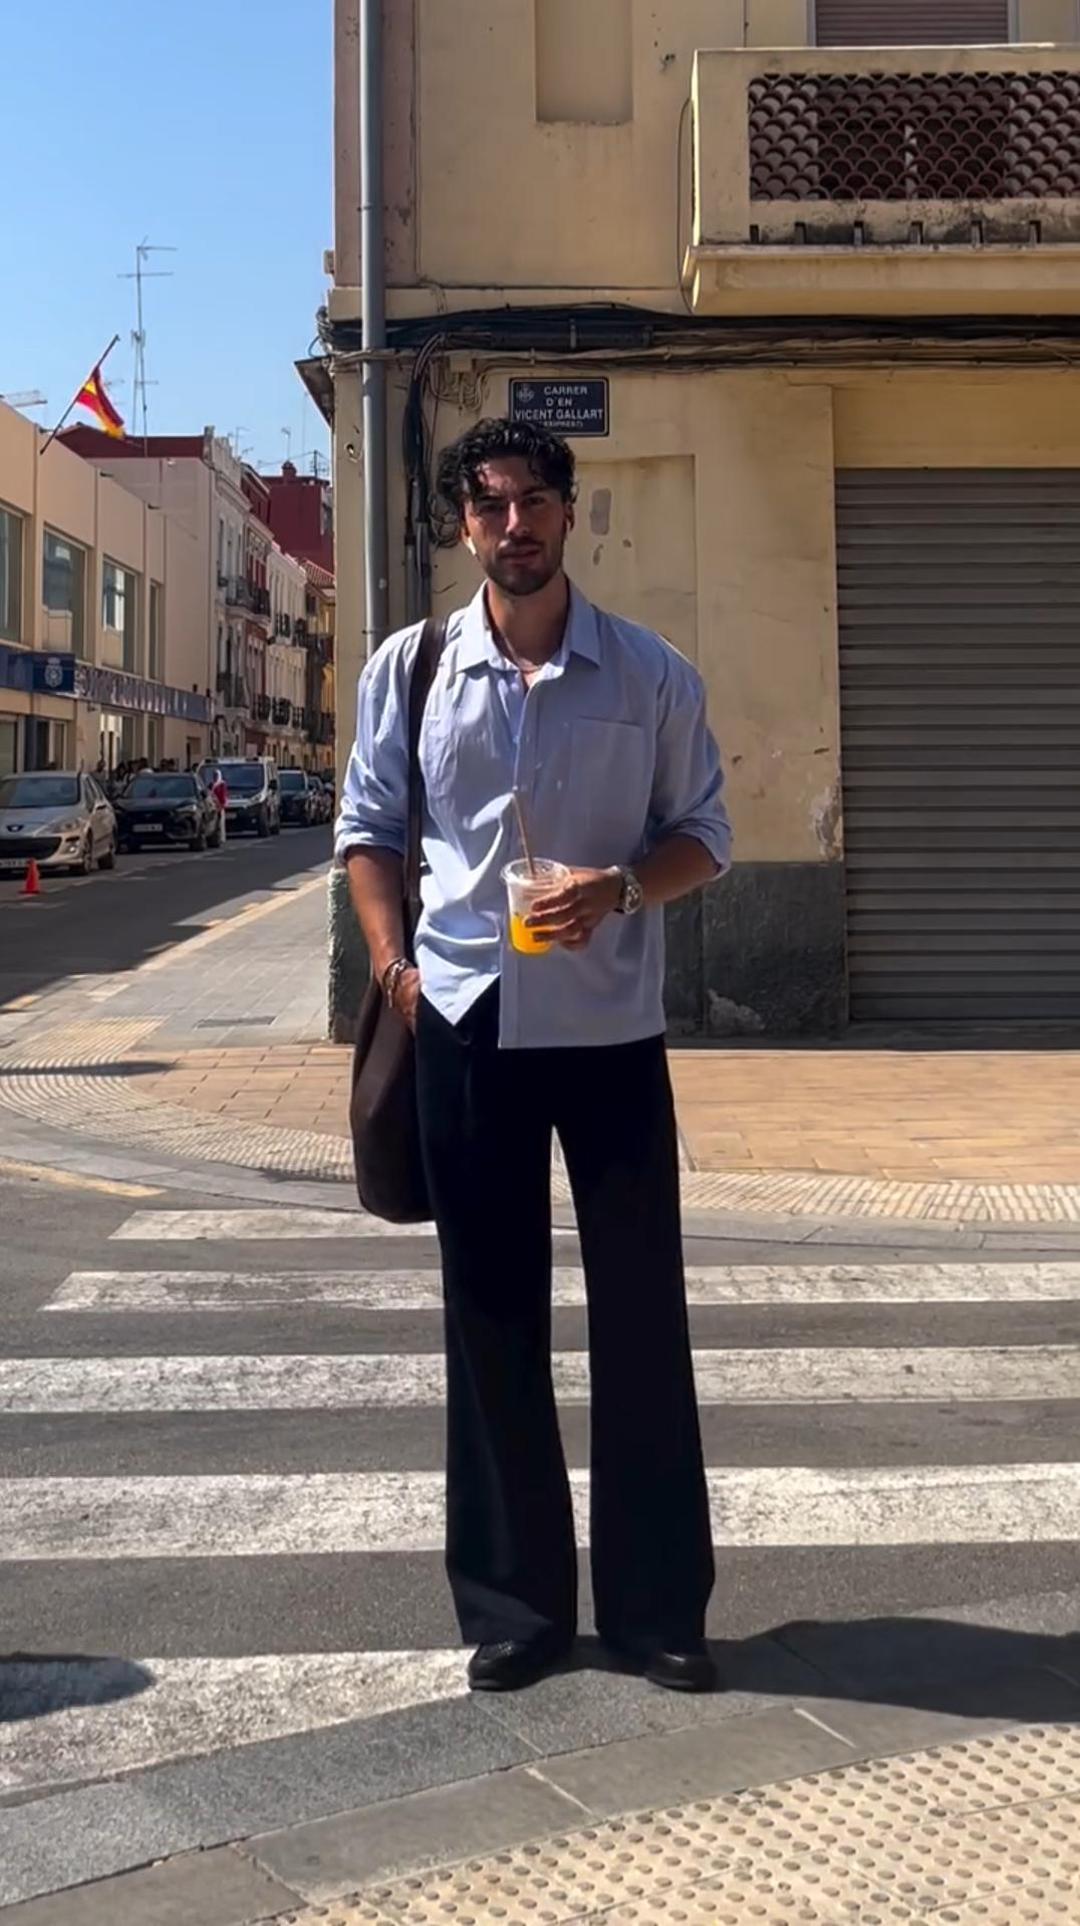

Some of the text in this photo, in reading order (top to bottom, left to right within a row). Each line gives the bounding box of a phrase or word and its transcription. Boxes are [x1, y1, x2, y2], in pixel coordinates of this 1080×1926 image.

[544, 386, 588, 396] CARRER
[546, 397, 573, 407] D'EN
[515, 408, 603, 421] VICENT GALLART
